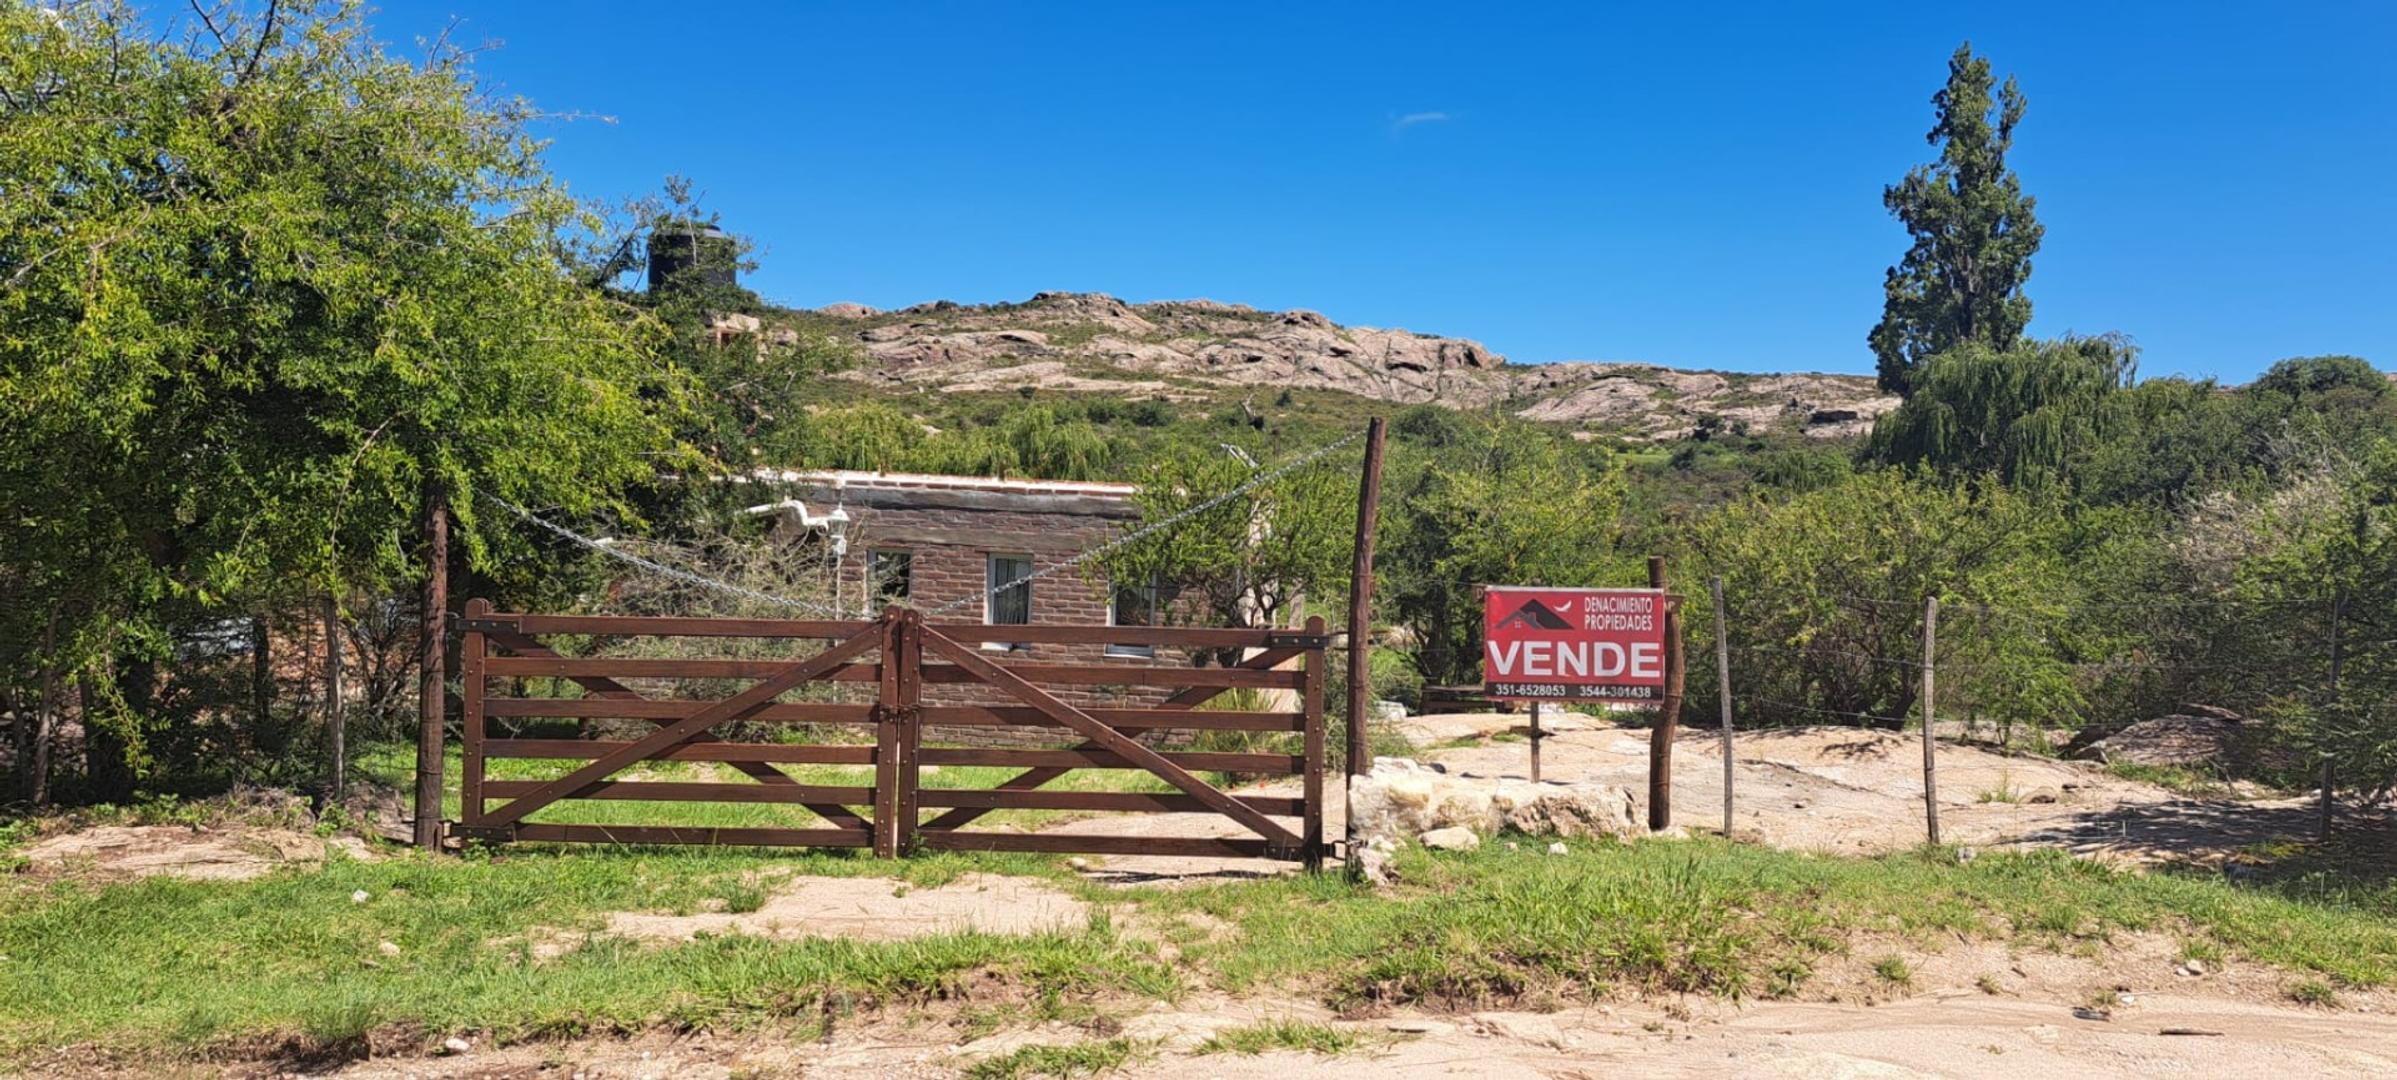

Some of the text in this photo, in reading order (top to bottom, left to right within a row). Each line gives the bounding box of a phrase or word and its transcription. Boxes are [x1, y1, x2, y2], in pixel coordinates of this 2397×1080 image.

[1584, 596, 1653, 613] DENACIMIENTO
[1584, 614, 1653, 631] PROPIEDADES
[1487, 640, 1661, 678] VENDE
[1495, 683, 1651, 698] 351-6528053 3544-301438
